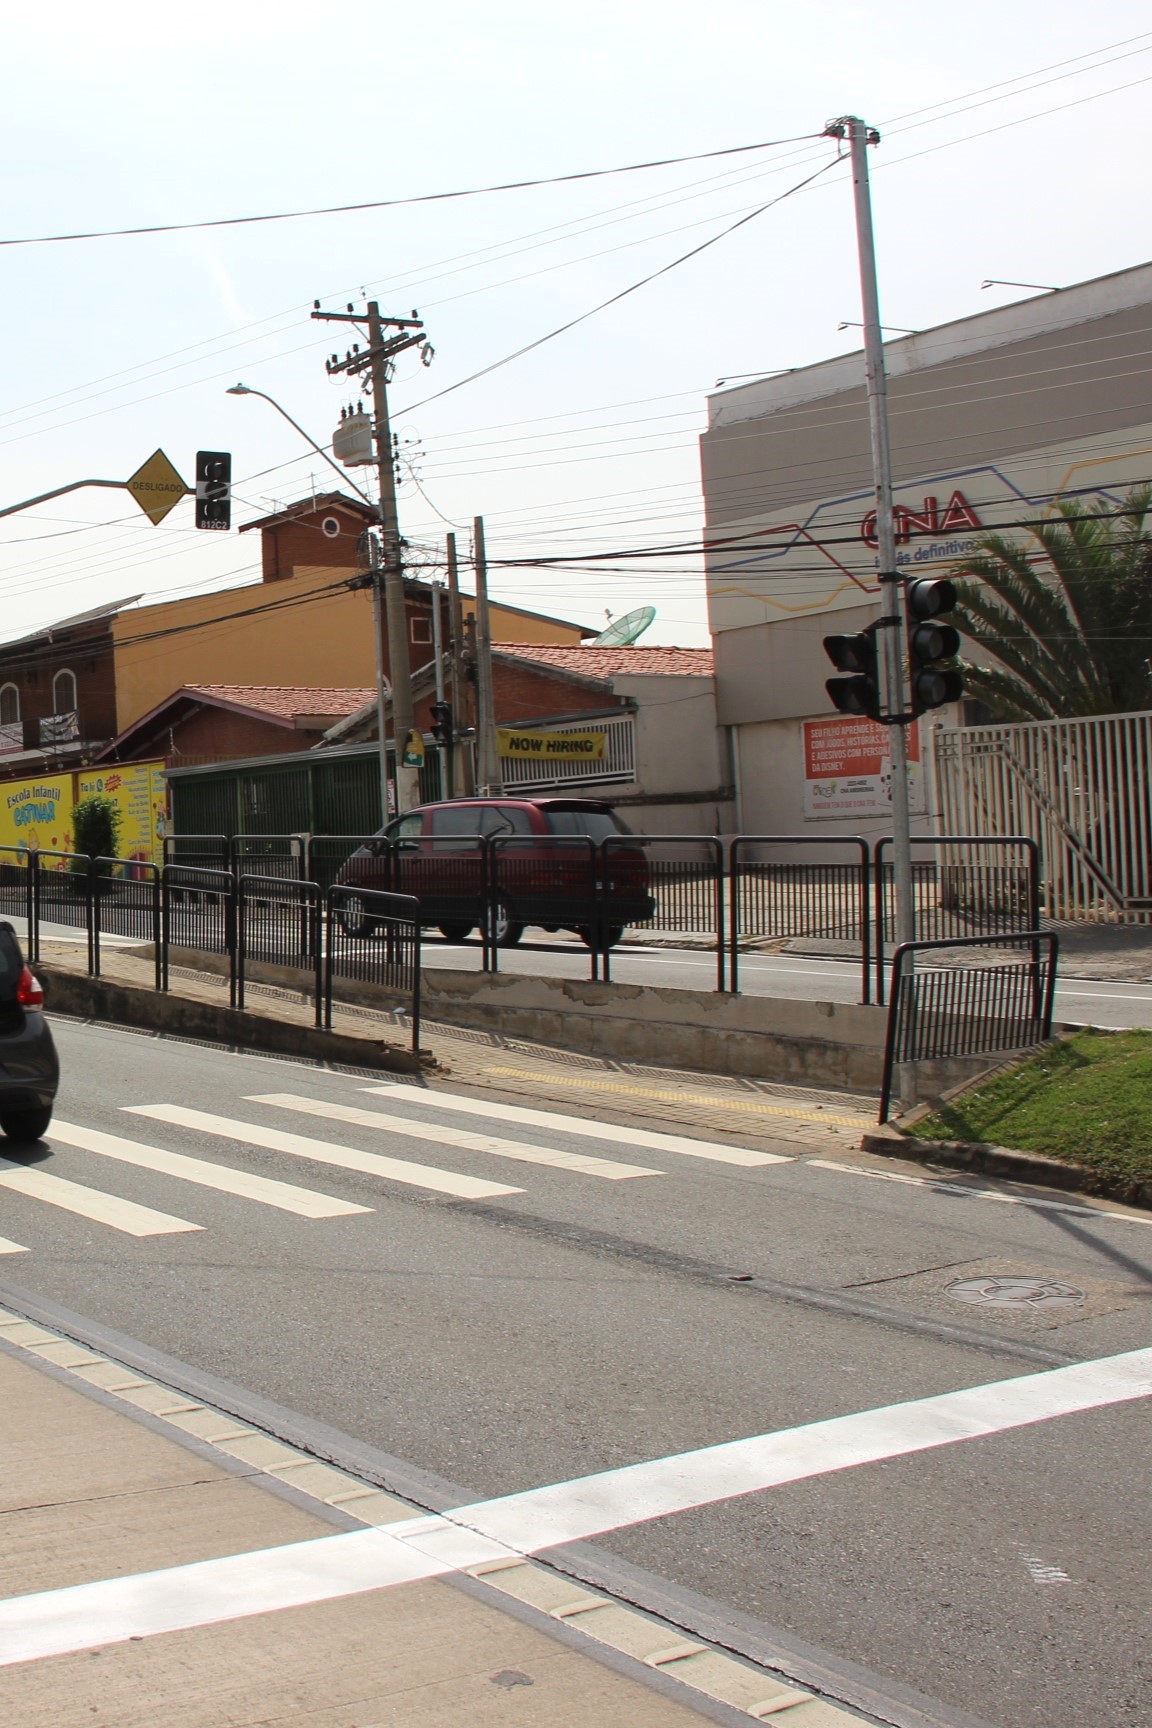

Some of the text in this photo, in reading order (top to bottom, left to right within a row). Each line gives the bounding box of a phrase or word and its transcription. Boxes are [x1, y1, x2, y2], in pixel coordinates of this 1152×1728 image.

[132, 481, 183, 493] DESLIGADO
[201, 520, 228, 530] 812C2
[841, 724, 870, 735] APRENDE
[509, 737, 594, 753] NOW HIRING
[7, 785, 61, 808] Escola Infantil
